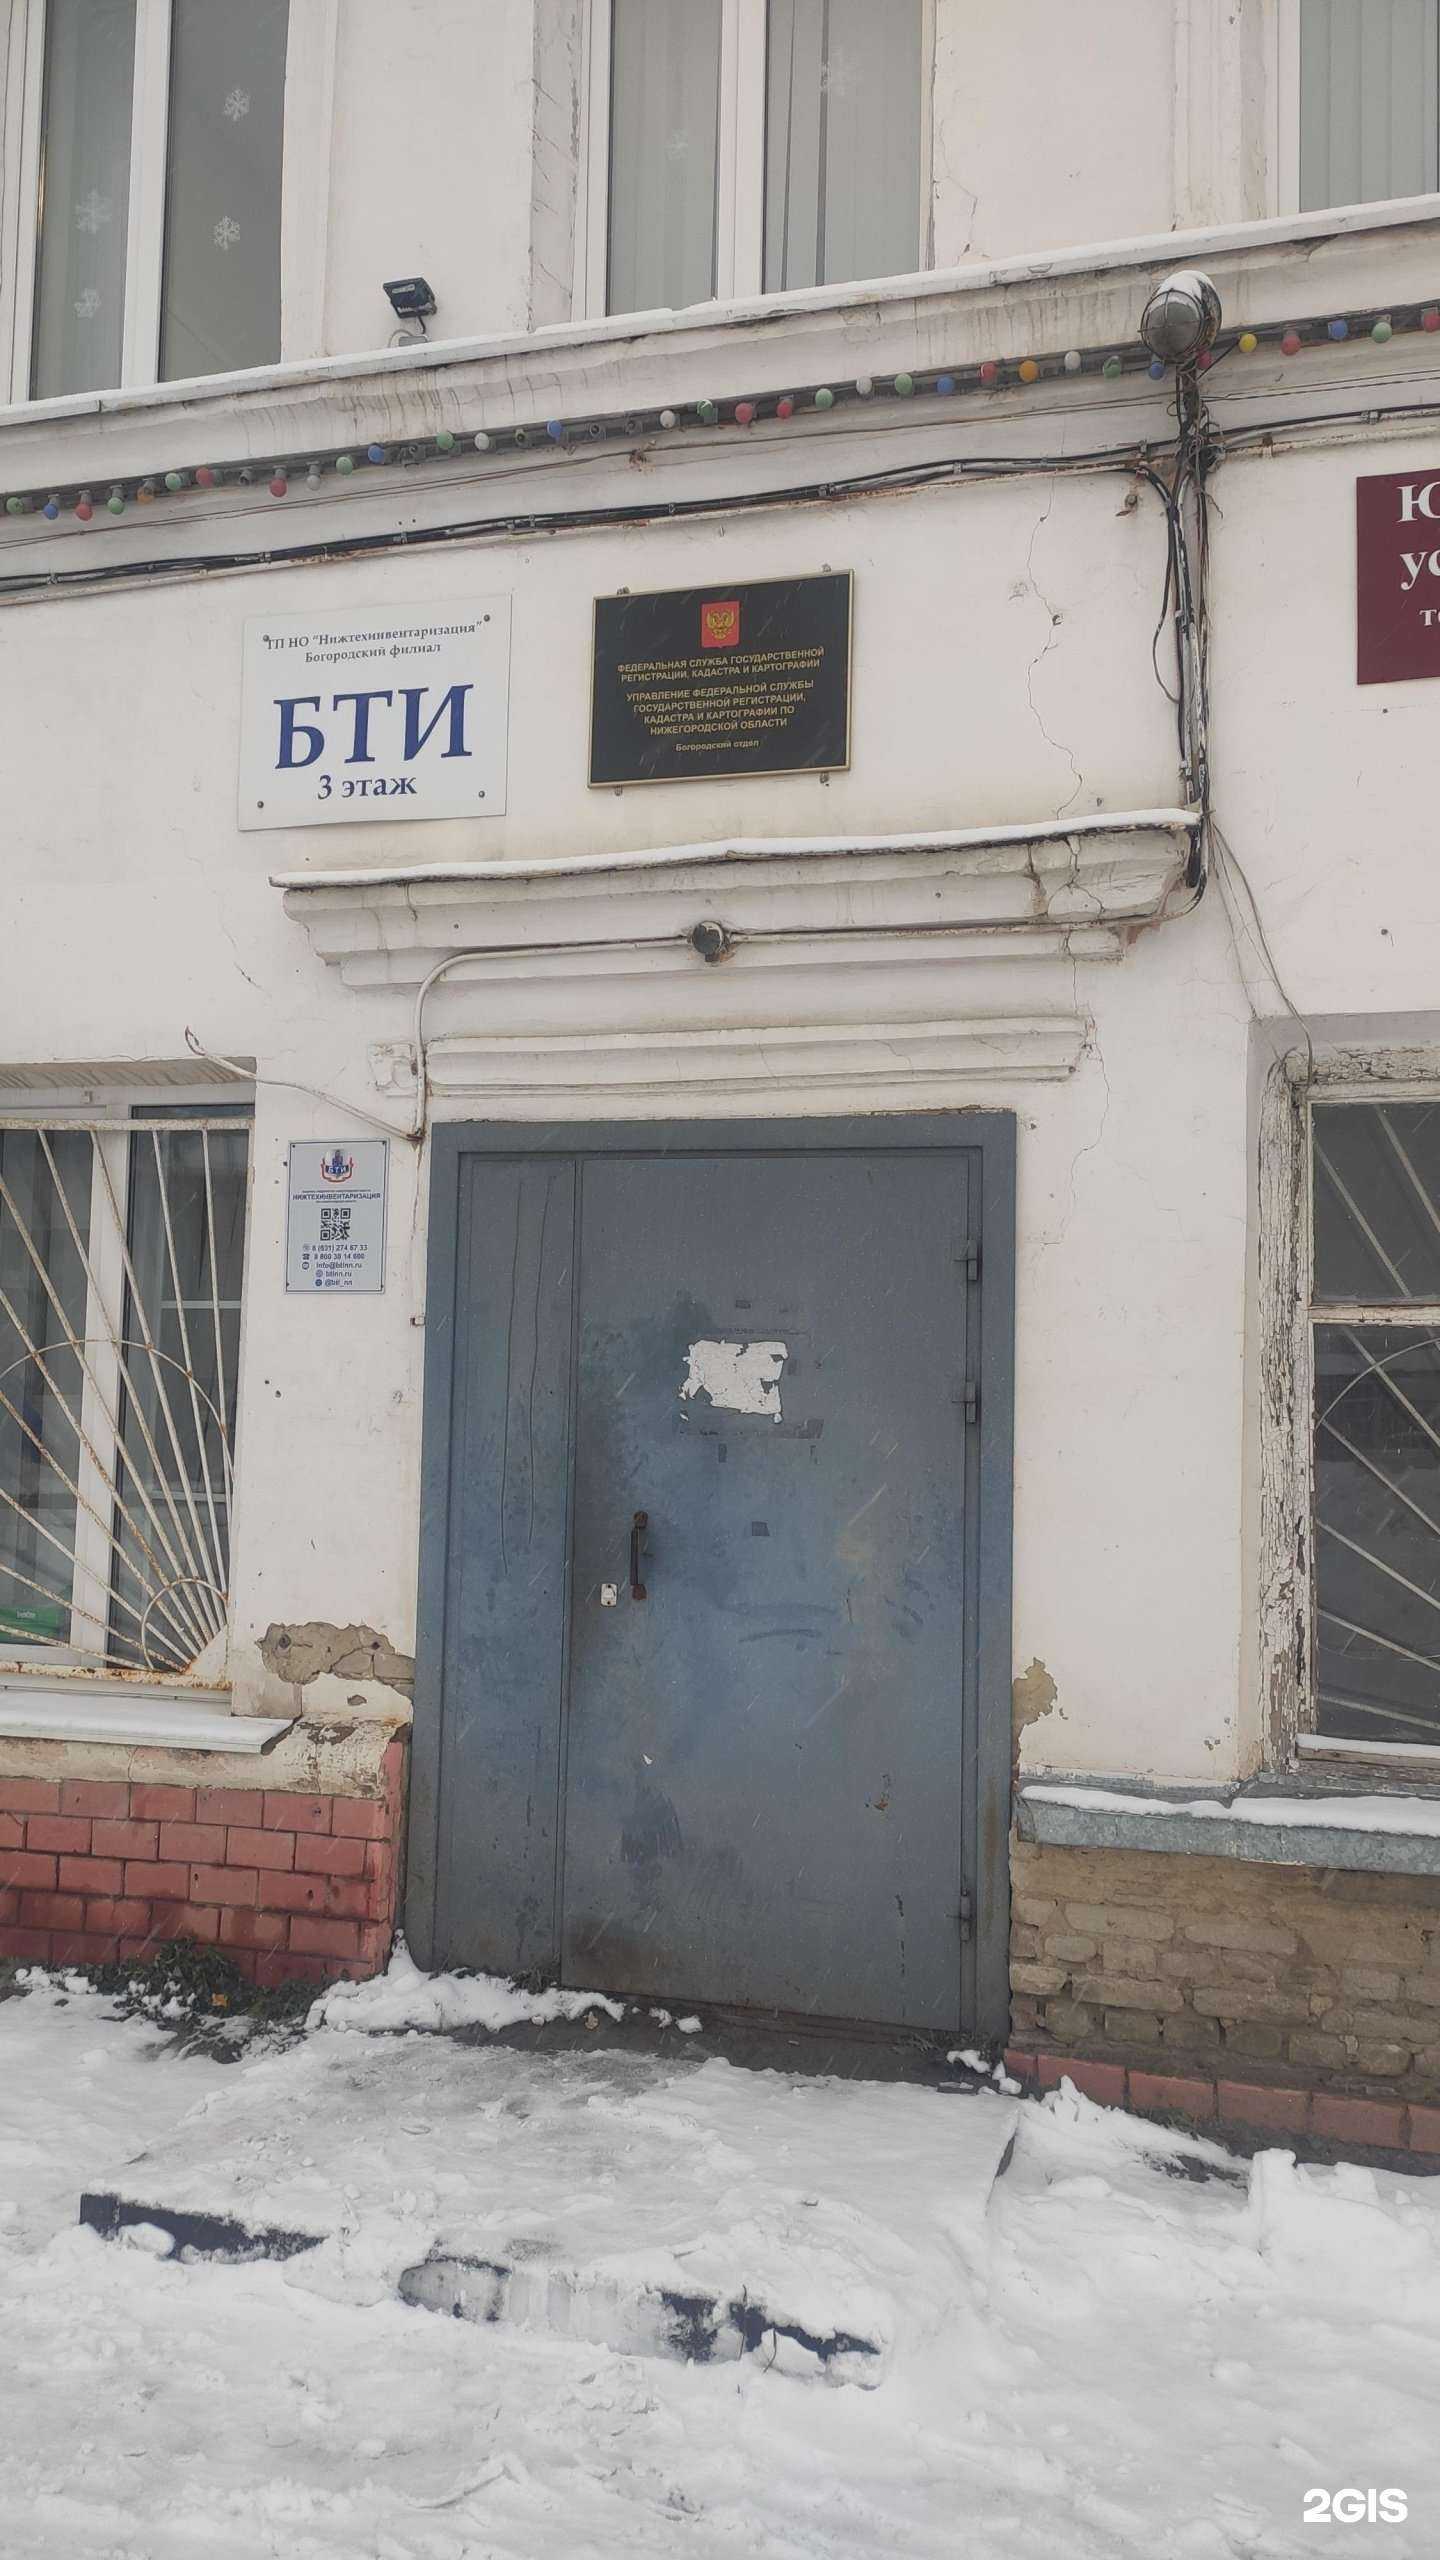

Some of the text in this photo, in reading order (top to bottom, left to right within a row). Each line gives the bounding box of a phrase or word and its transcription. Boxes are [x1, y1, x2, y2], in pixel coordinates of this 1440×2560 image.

[1419, 608, 1440, 627] т
[288, 636, 309, 648] НО
[305, 644, 441, 663] Богородский филиал
[617, 646, 825, 673] ФЕДЕРАЛЬНАЯ СЛУЖБА ГОСУДАРСТВЕННОЙ
[621, 659, 820, 682] РЕГИСТРАЦИИ, КАДАСТРА И КАРТОГРАФИИ
[626, 679, 814, 702] УПРАВЛЕНИЕ ФЕДЕРАЛЬНОЙ СЛУЖБЫ
[633, 692, 806, 713] ГОСУДАРСТВЕННОЙ РЕГИСТРАЦИИ,
[644, 705, 795, 724] КАДАСТРА И КАРТОГРАФИИ ПО
[273, 683, 474, 770] БТИ
[650, 717, 788, 735] НИЖЕГОРОДСКОЙ ОБЛАСТИ
[676, 739, 760, 752] Богородский отдел
[318, 774, 418, 800] 3 этаж
[328, 1165, 347, 1174] БТИ
